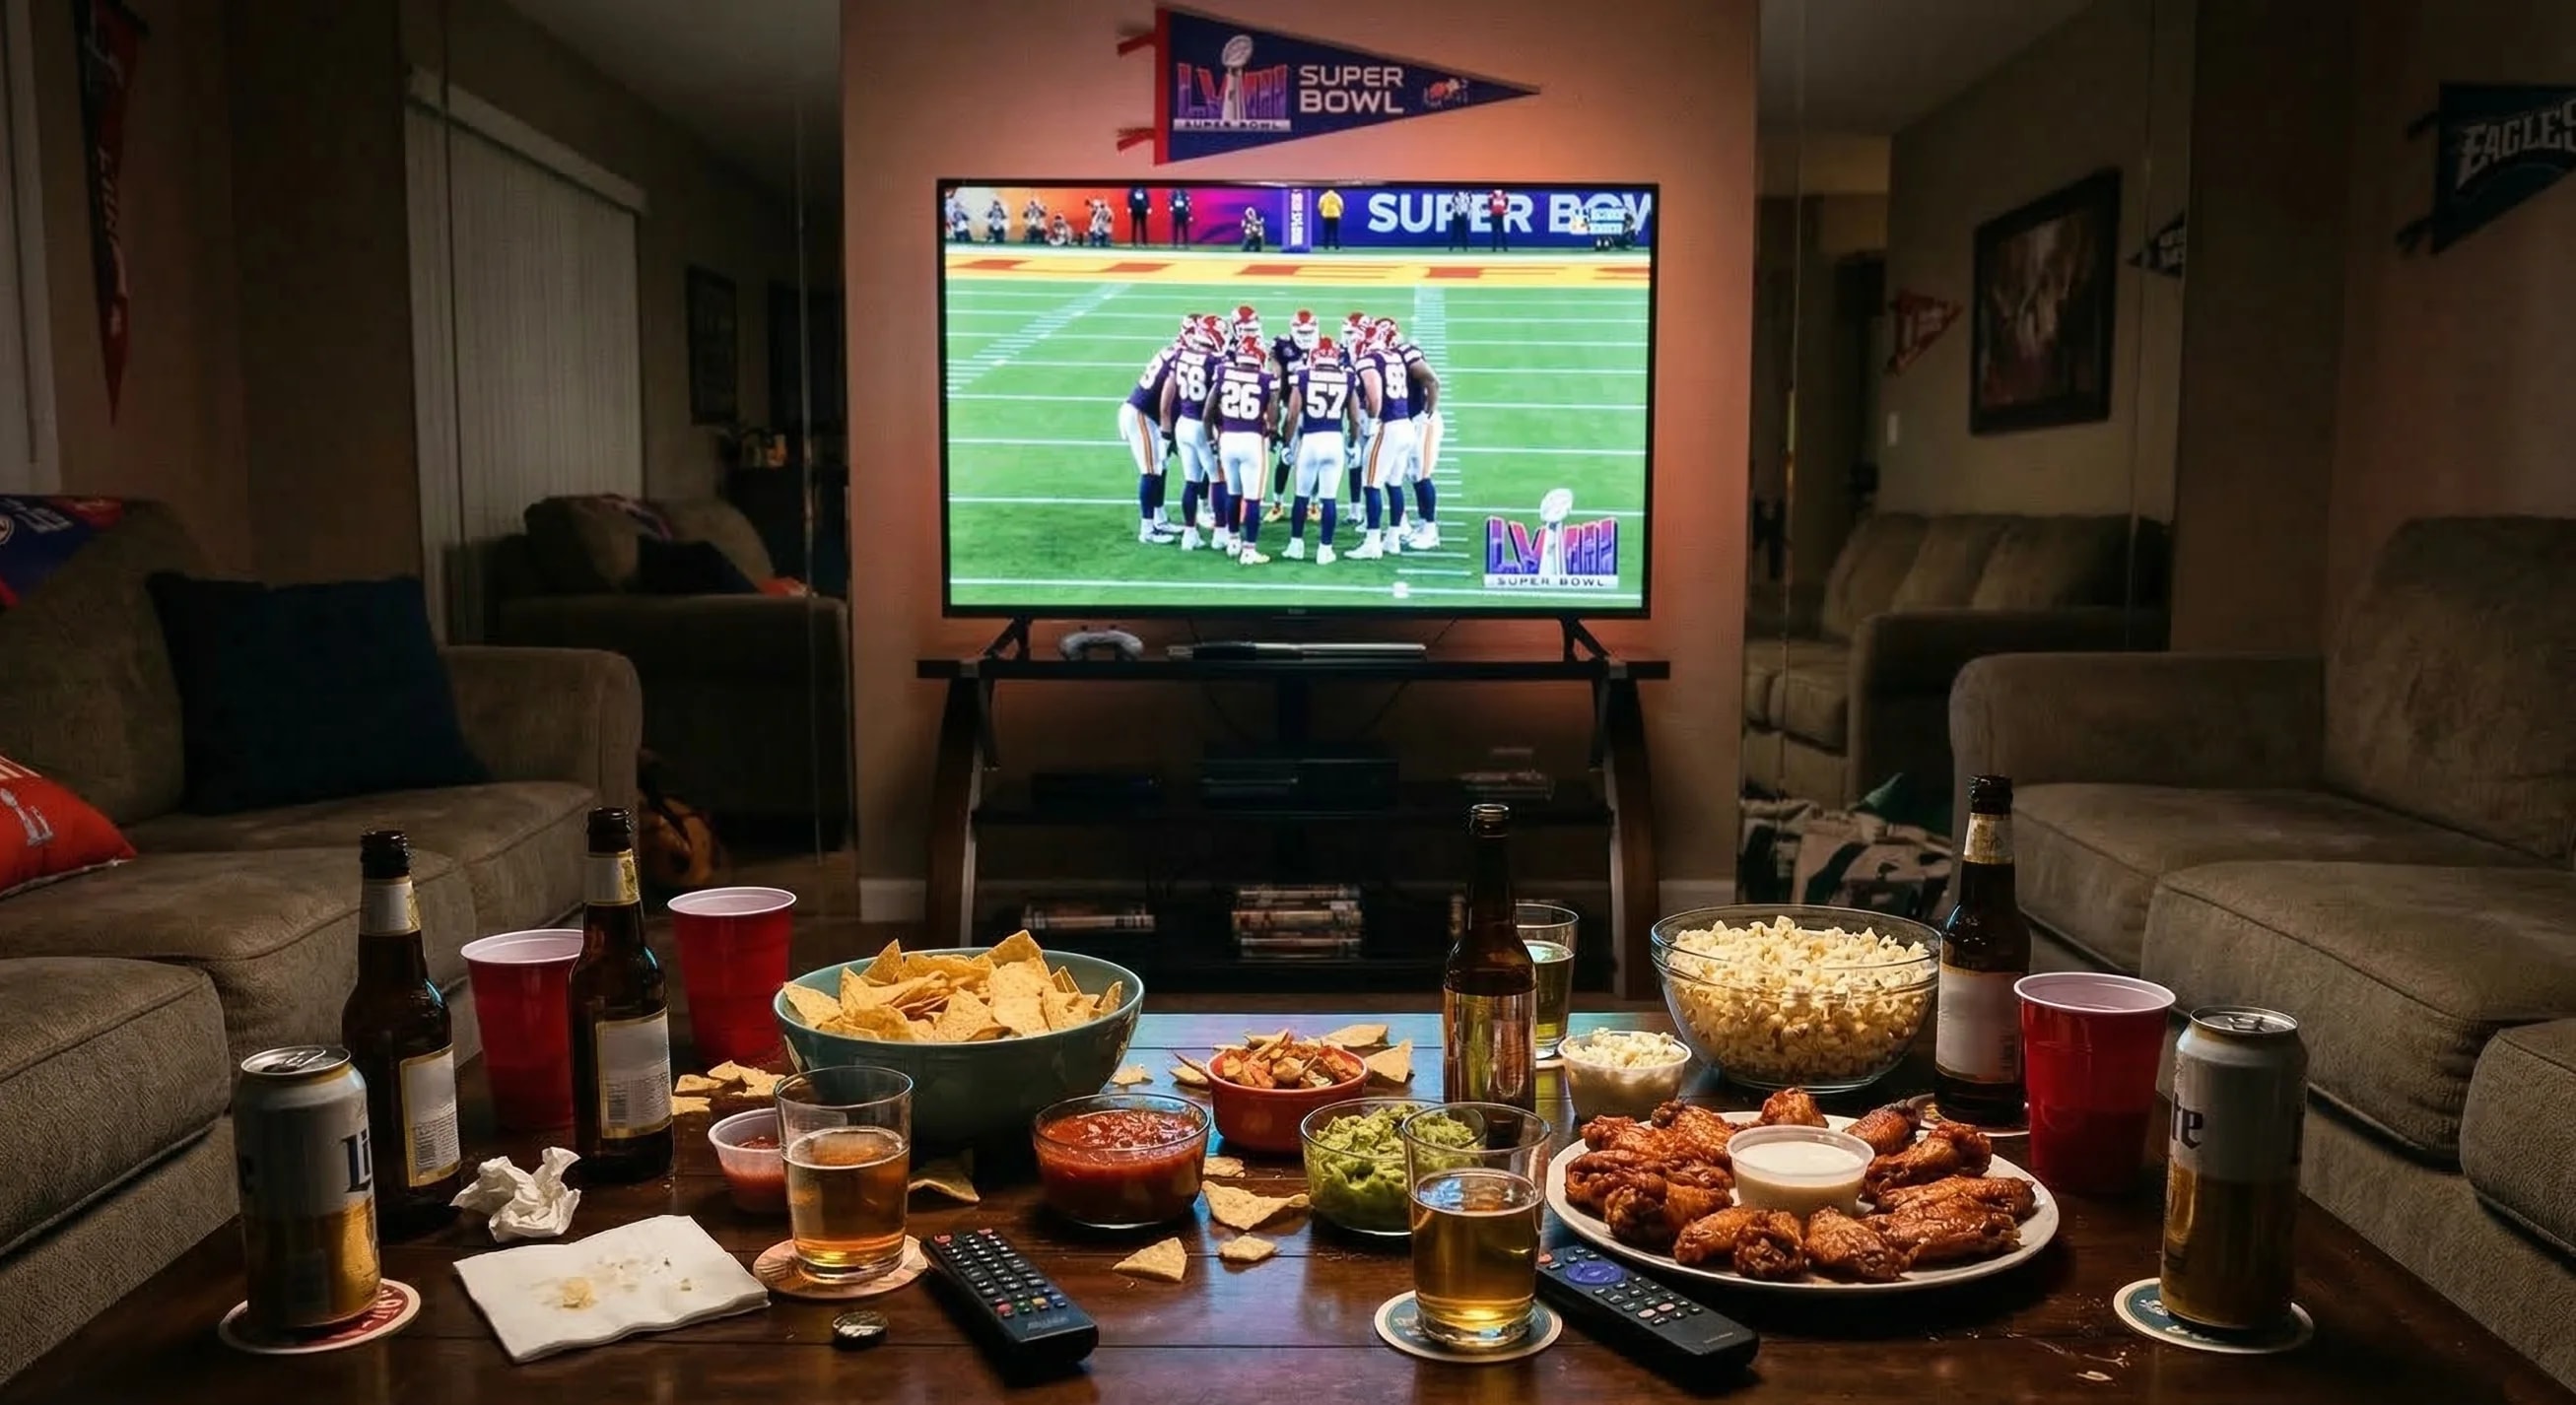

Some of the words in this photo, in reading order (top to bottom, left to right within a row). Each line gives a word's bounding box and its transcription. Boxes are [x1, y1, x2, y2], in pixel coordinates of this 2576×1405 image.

[1299, 65, 1403, 87] SUPER
[1299, 90, 1404, 113] BOWL
[1368, 192, 1533, 233] SUPER
[1221, 380, 1261, 420] 26
[1307, 381, 1348, 419] 57
[1497, 577, 1550, 586] SUPER
[1559, 577, 1605, 587] BOWL
